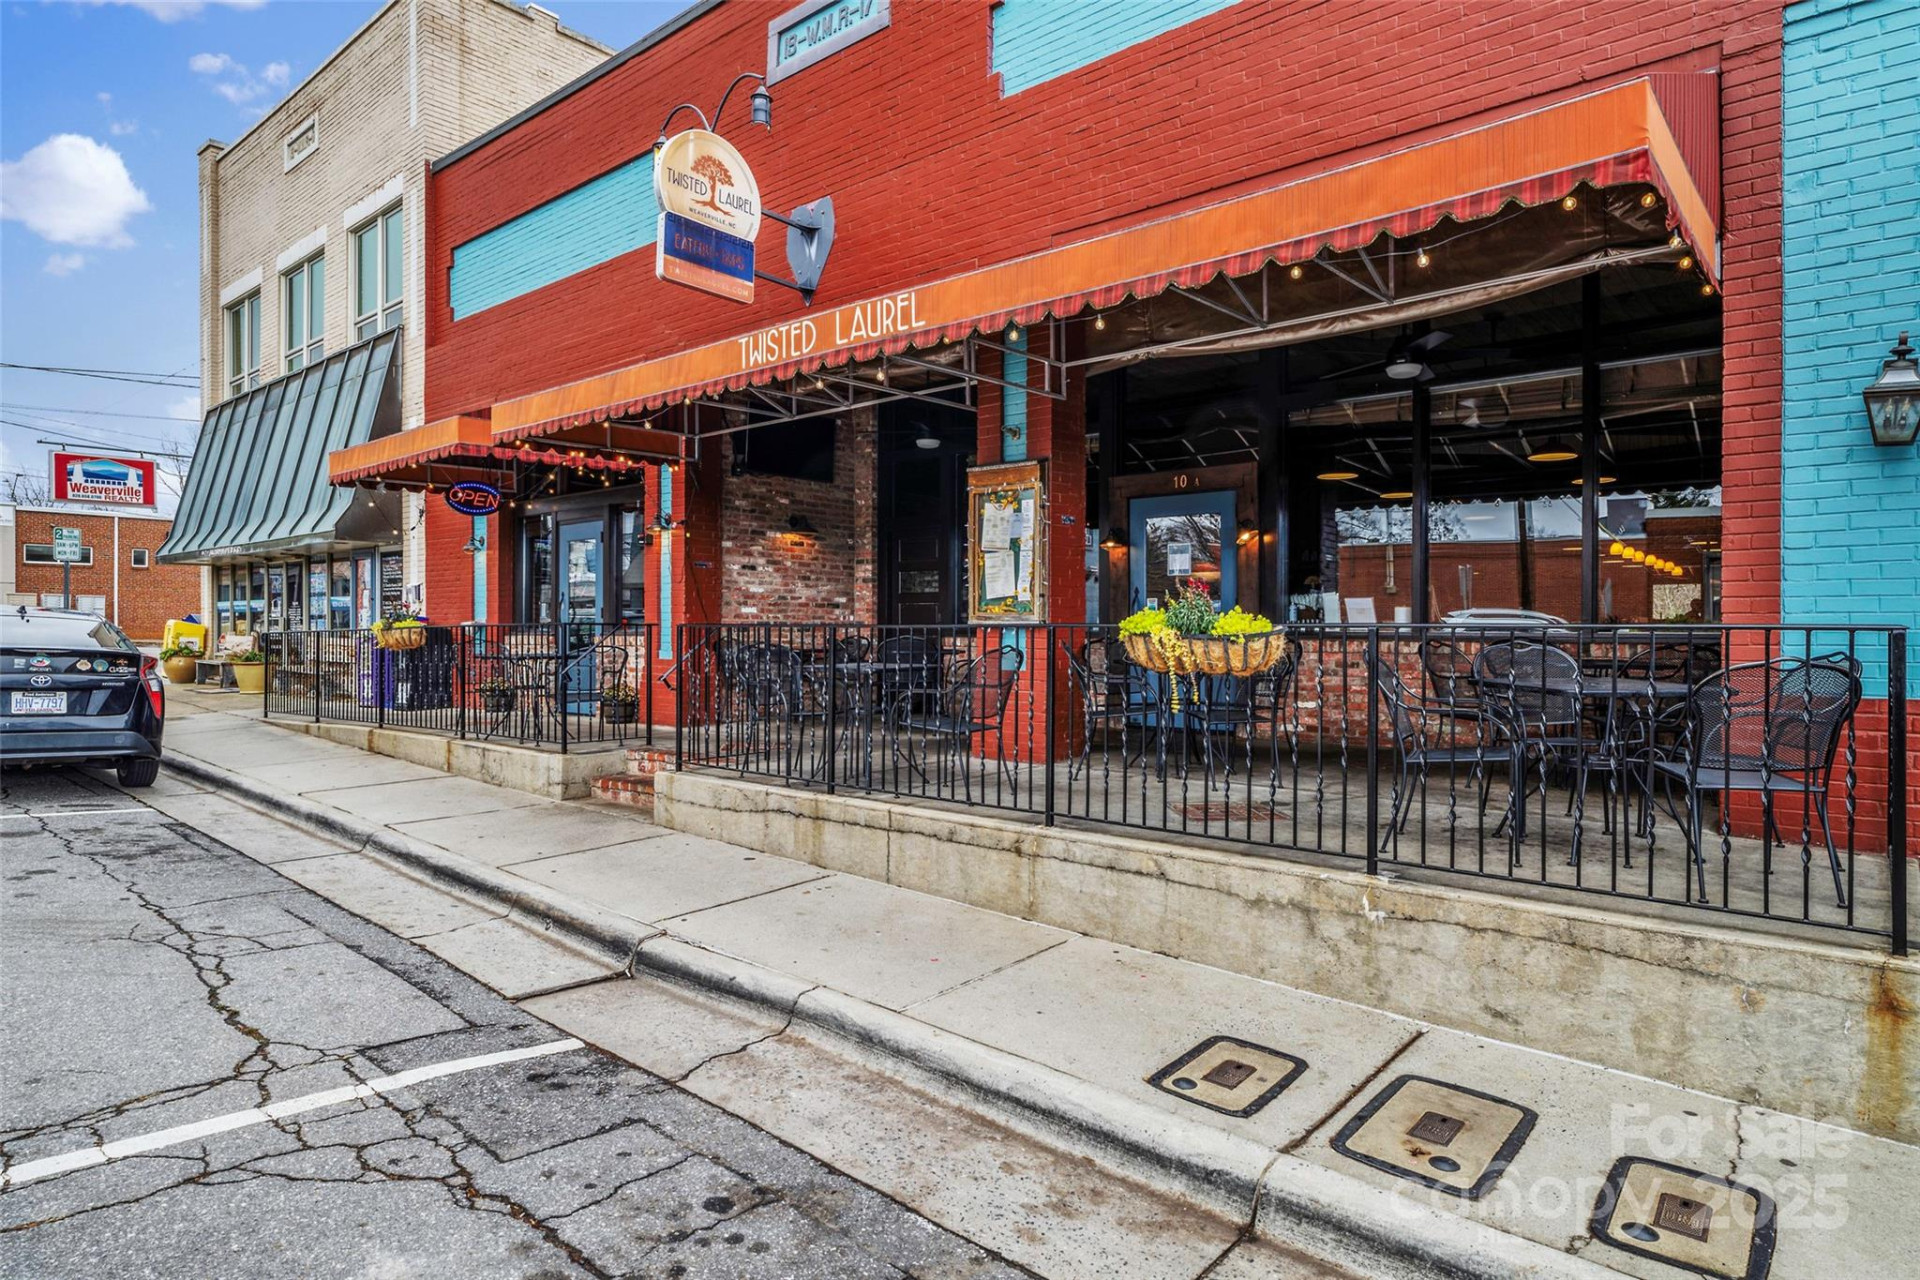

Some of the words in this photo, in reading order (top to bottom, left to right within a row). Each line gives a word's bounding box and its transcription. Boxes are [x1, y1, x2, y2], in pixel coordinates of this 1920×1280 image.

[667, 167, 708, 196] TWISTED
[718, 188, 755, 216] LAUREL
[738, 320, 817, 369] TWISTED
[835, 291, 926, 345] LAUREL
[1173, 474, 1188, 489] 10
[69, 482, 141, 497] Weaverville
[104, 494, 141, 502] REALTY
[449, 487, 500, 509] OPEN
[56, 529, 62, 538] 2
[15, 697, 64, 708] HHV-7797
